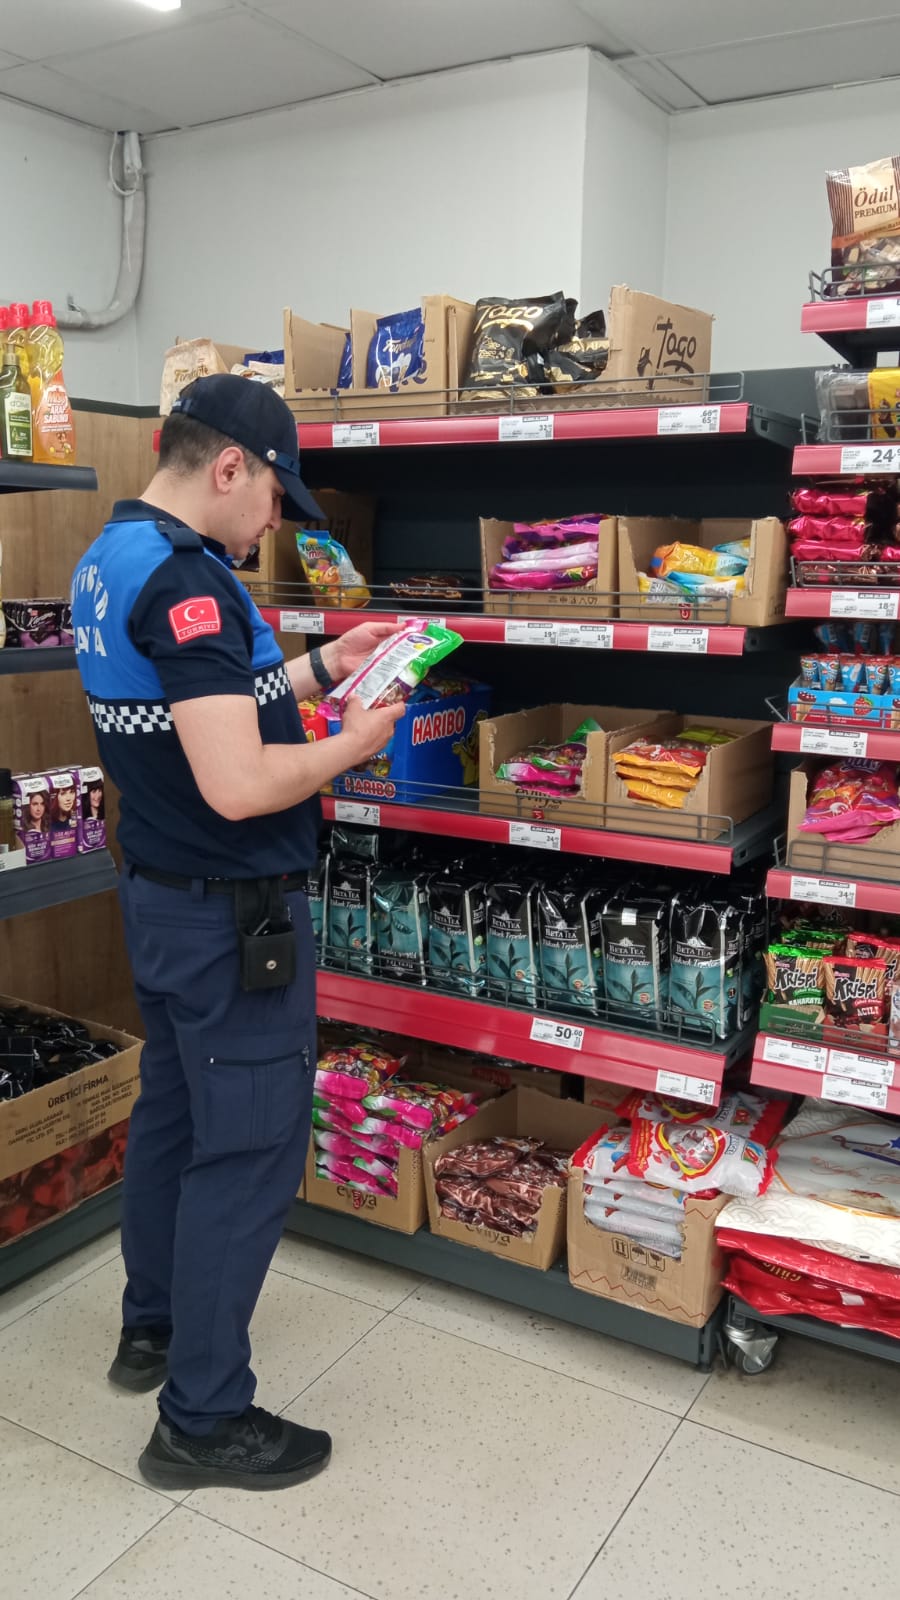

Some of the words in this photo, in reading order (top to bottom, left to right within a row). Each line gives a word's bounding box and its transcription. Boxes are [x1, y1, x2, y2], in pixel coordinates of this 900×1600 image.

[854, 185, 893, 207] Ödül
[854, 203, 897, 219] PREMIUM
[412, 706, 466, 747] HARIBO
[344, 776, 397, 799] HARIBO
[48, 1086, 81, 1108] ÜRETİCİ
[83, 1074, 109, 1093] FİRMA
